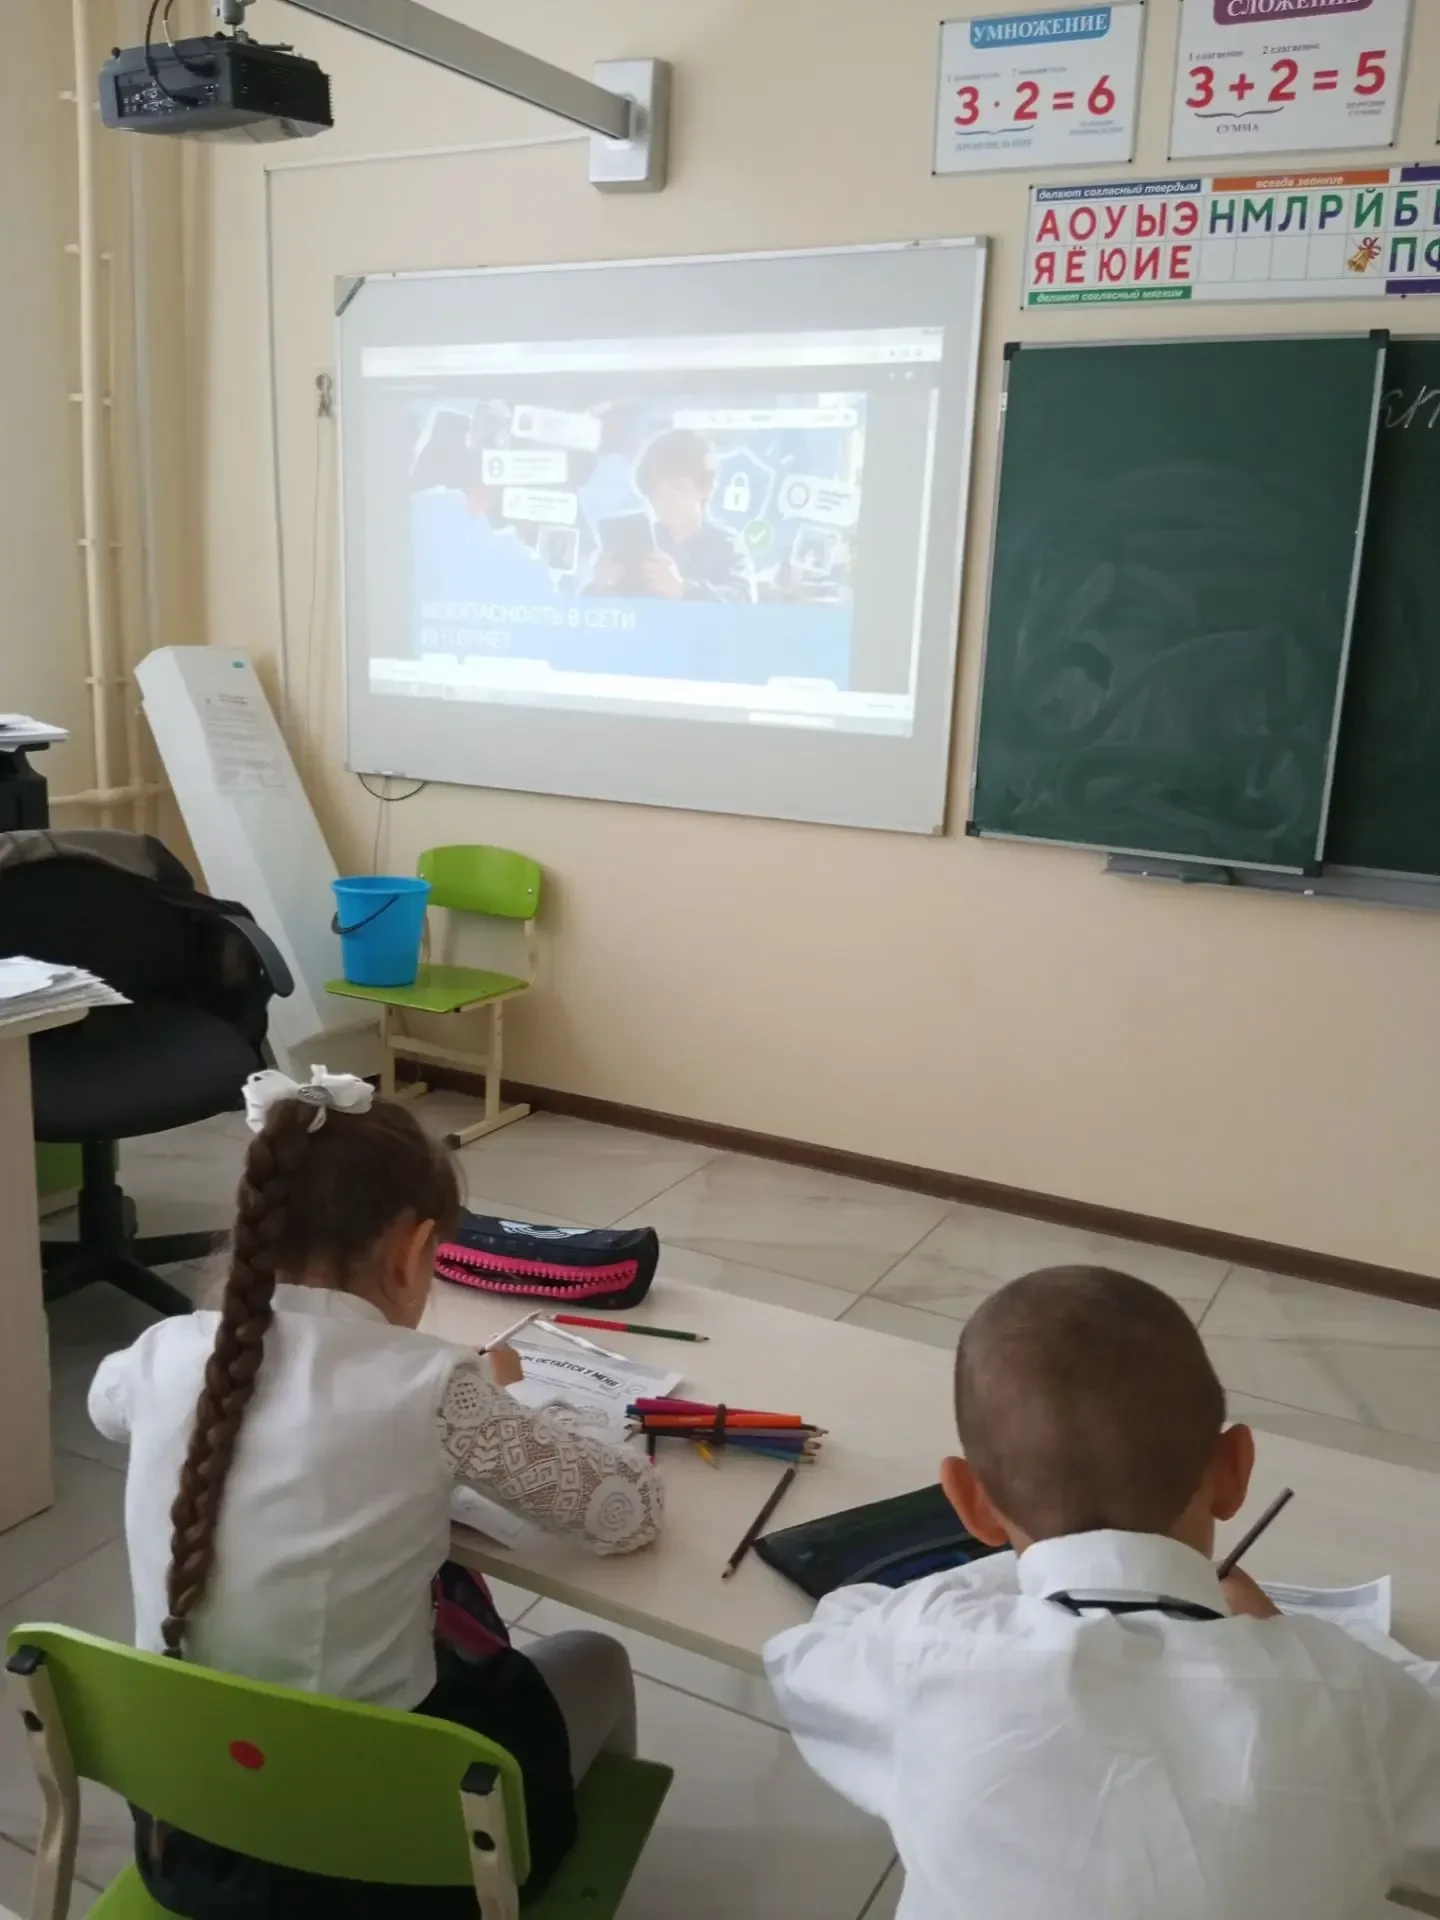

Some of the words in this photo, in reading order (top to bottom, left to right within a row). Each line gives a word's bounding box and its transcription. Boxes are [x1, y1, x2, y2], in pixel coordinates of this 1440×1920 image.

[1226, 0, 1361, 17] СЛОЖ
[972, 14, 1108, 42] УМНОЖЕНИЕ
[1185, 65, 1214, 109] 3
[1267, 58, 1298, 103] 2
[1353, 50, 1386, 96] 5
[954, 85, 980, 126] 3
[1013, 80, 1040, 121] 2
[1087, 74, 1116, 116] 6
[1215, 123, 1260, 135] СУММА
[1038, 188, 1082, 200] делают
[1083, 184, 1142, 198] согласный
[1144, 181, 1199, 196] твердым
[1255, 175, 1294, 189] всегда
[1295, 175, 1344, 188] звонкие
[1036, 291, 1080, 303] делают
[1081, 288, 1140, 301] согласный
[568, 608, 581, 628] В
[585, 608, 637, 630] СЕТИ
